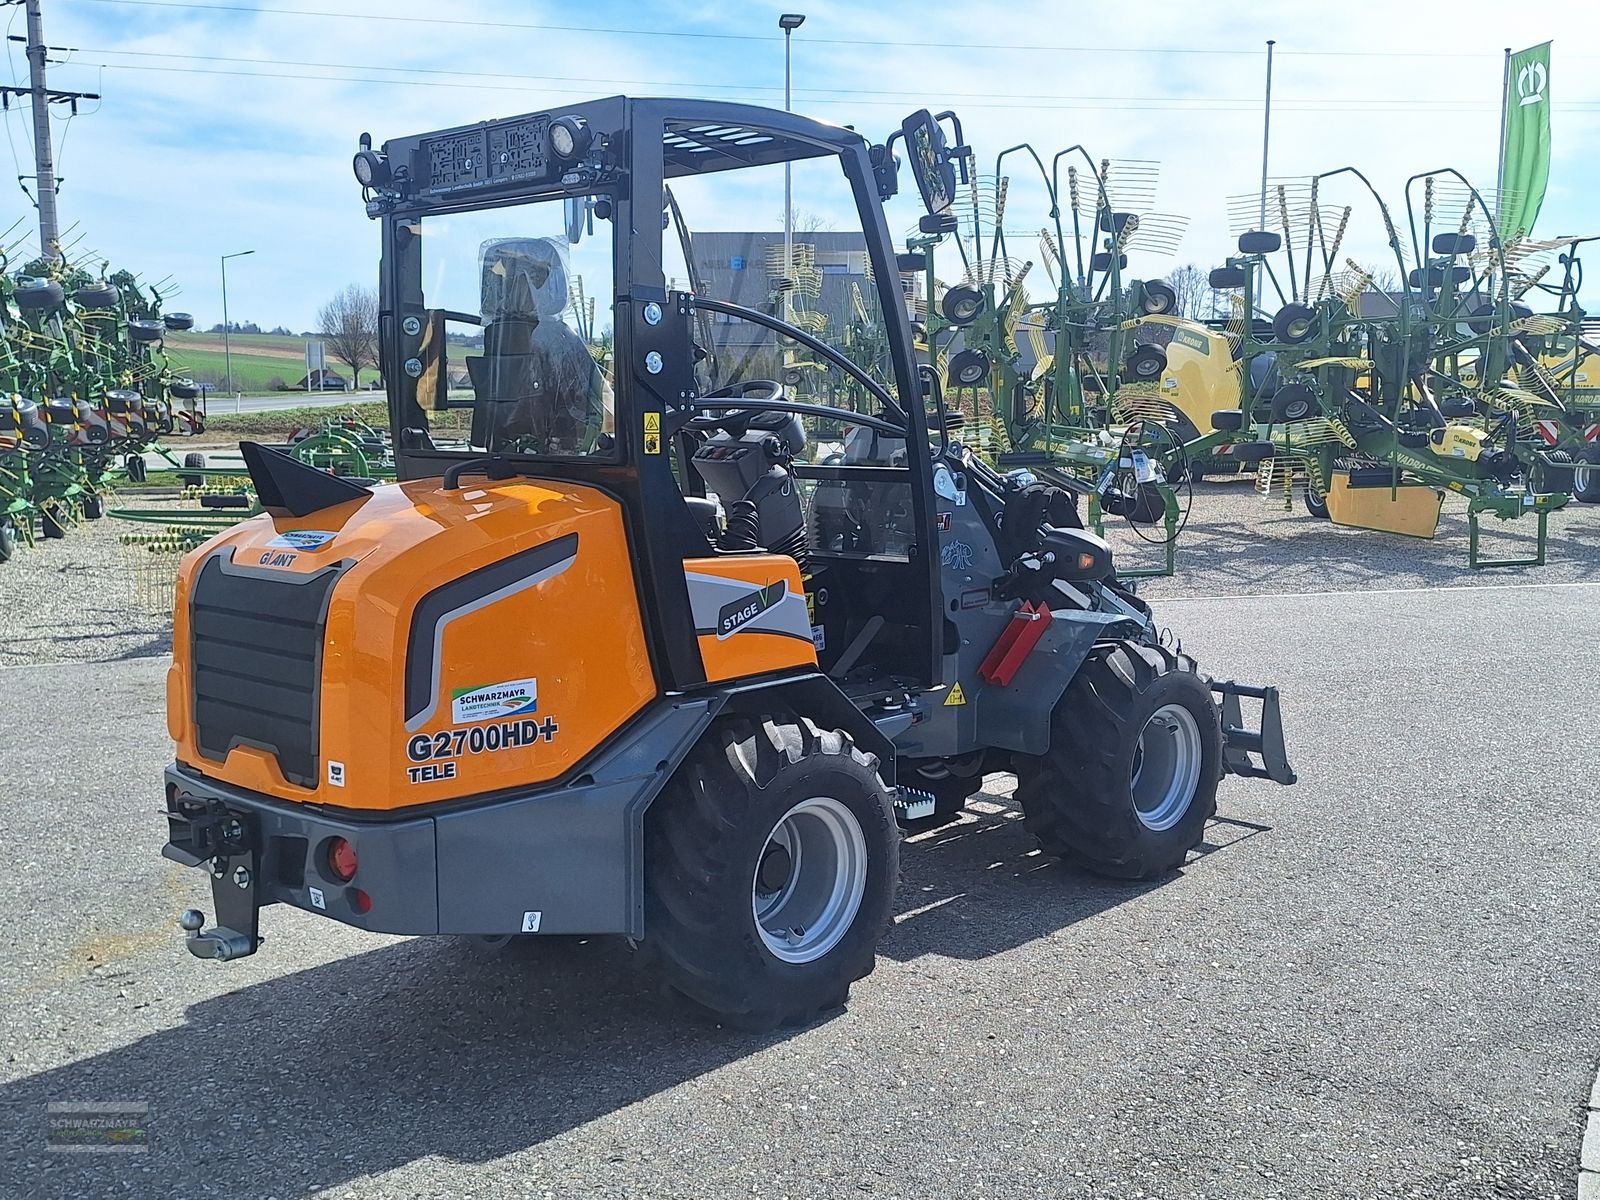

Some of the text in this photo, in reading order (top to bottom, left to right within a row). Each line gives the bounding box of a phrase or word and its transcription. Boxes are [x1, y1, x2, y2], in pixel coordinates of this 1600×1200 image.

[723, 603, 758, 630] STAGE
[460, 688, 525, 704] SCHWARZMAYR
[461, 701, 501, 711] LANDTECHNIK
[407, 717, 558, 761] G2700HD+
[408, 763, 455, 783] TELE
